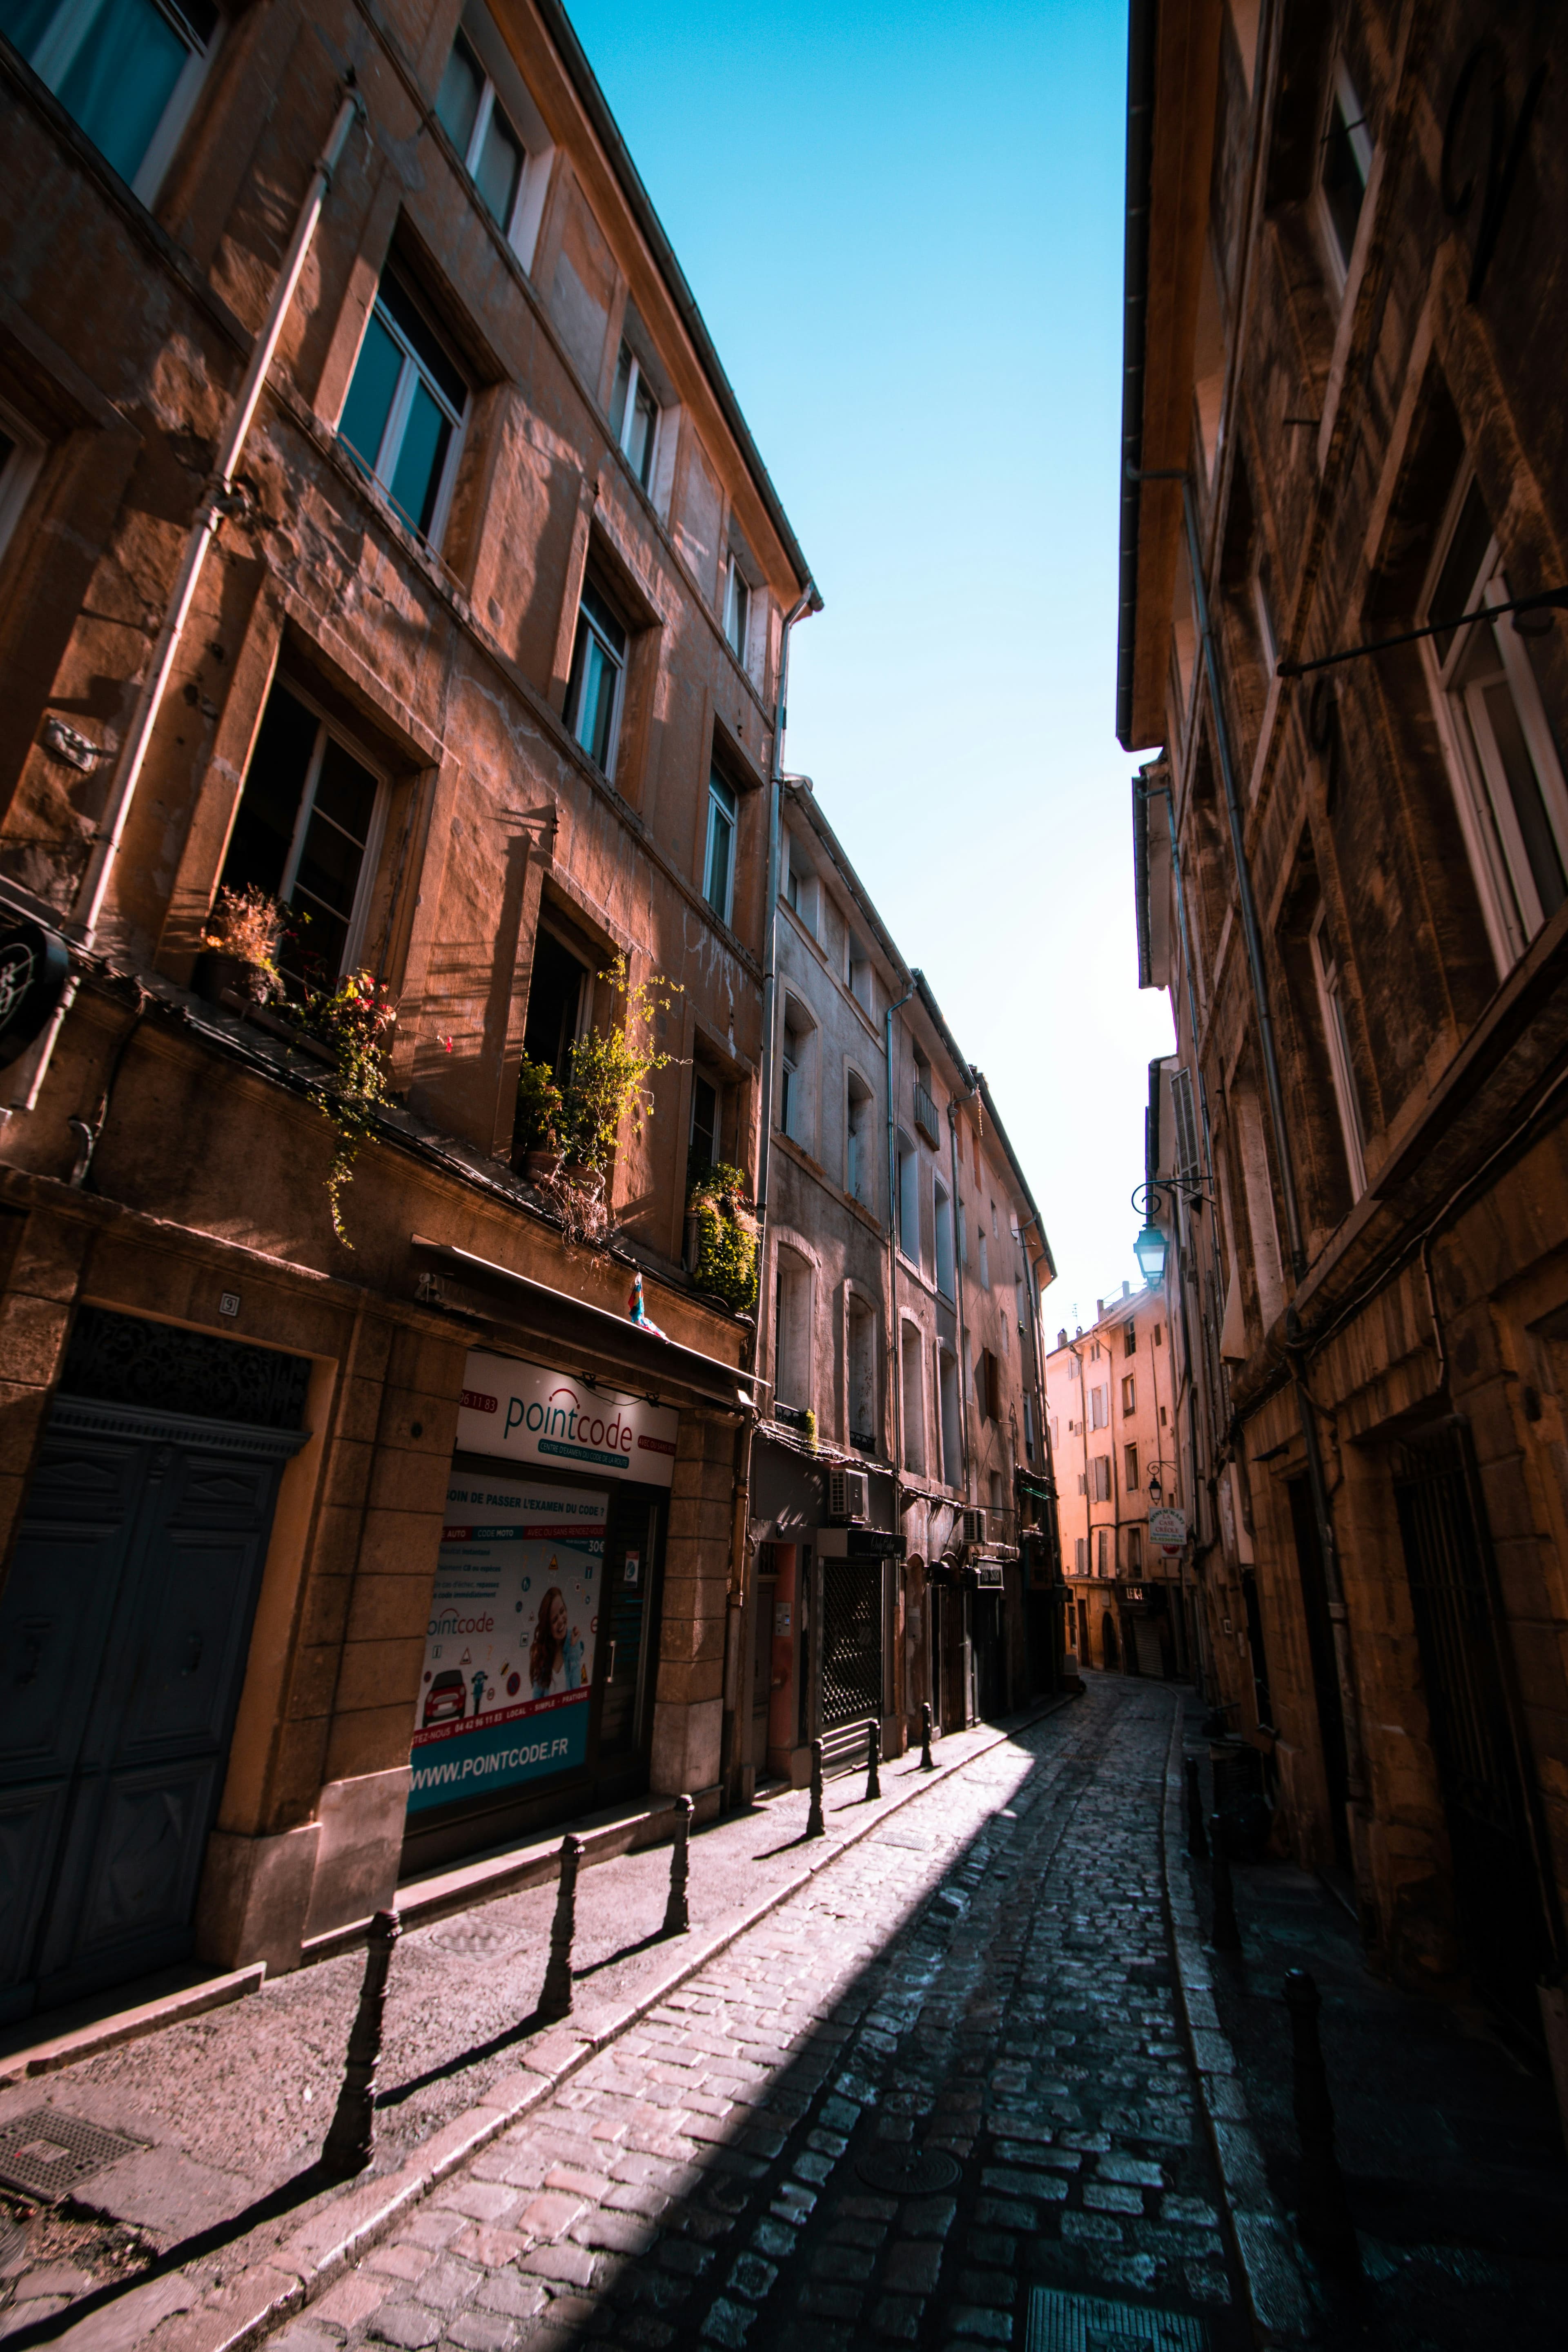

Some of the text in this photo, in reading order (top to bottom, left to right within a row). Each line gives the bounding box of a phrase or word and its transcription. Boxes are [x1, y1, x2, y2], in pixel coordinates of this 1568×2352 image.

[226, 1299, 232, 1310] 9
[473, 1395, 482, 1408] 11
[484, 1398, 495, 1411] 83
[504, 1396, 632, 1452] pointcode
[638, 1438, 649, 1447] AVEC
[650, 1441, 657, 1449] OU
[657, 1443, 667, 1452] SANS
[540, 1442, 559, 1454] CENTRE
[559, 1446, 582, 1458] D'EXAMEN
[582, 1450, 589, 1459] DU
[590, 1452, 601, 1461] CODE
[608, 1455, 614, 1463] LA
[614, 1457, 628, 1467] ROUTE
[447, 1490, 604, 1517] OIN DE PASSER L'EXAMEN DU CODE ?
[1150, 1510, 1185, 1524] RESTAURANT
[447, 1530, 466, 1538] AUTO
[527, 1528, 543, 1537] AVEC
[568, 1528, 604, 1536] RENDEZ-VOUS
[588, 1540, 604, 1553] 30€
[427, 1612, 494, 1636] ointcode
[414, 1690, 588, 1744] TEZ-NOUS 04 42 96 11 83 LOCAL SIMPLE PRATIQUE
[410, 1737, 568, 1792] WWW.POINTCODE.FR
